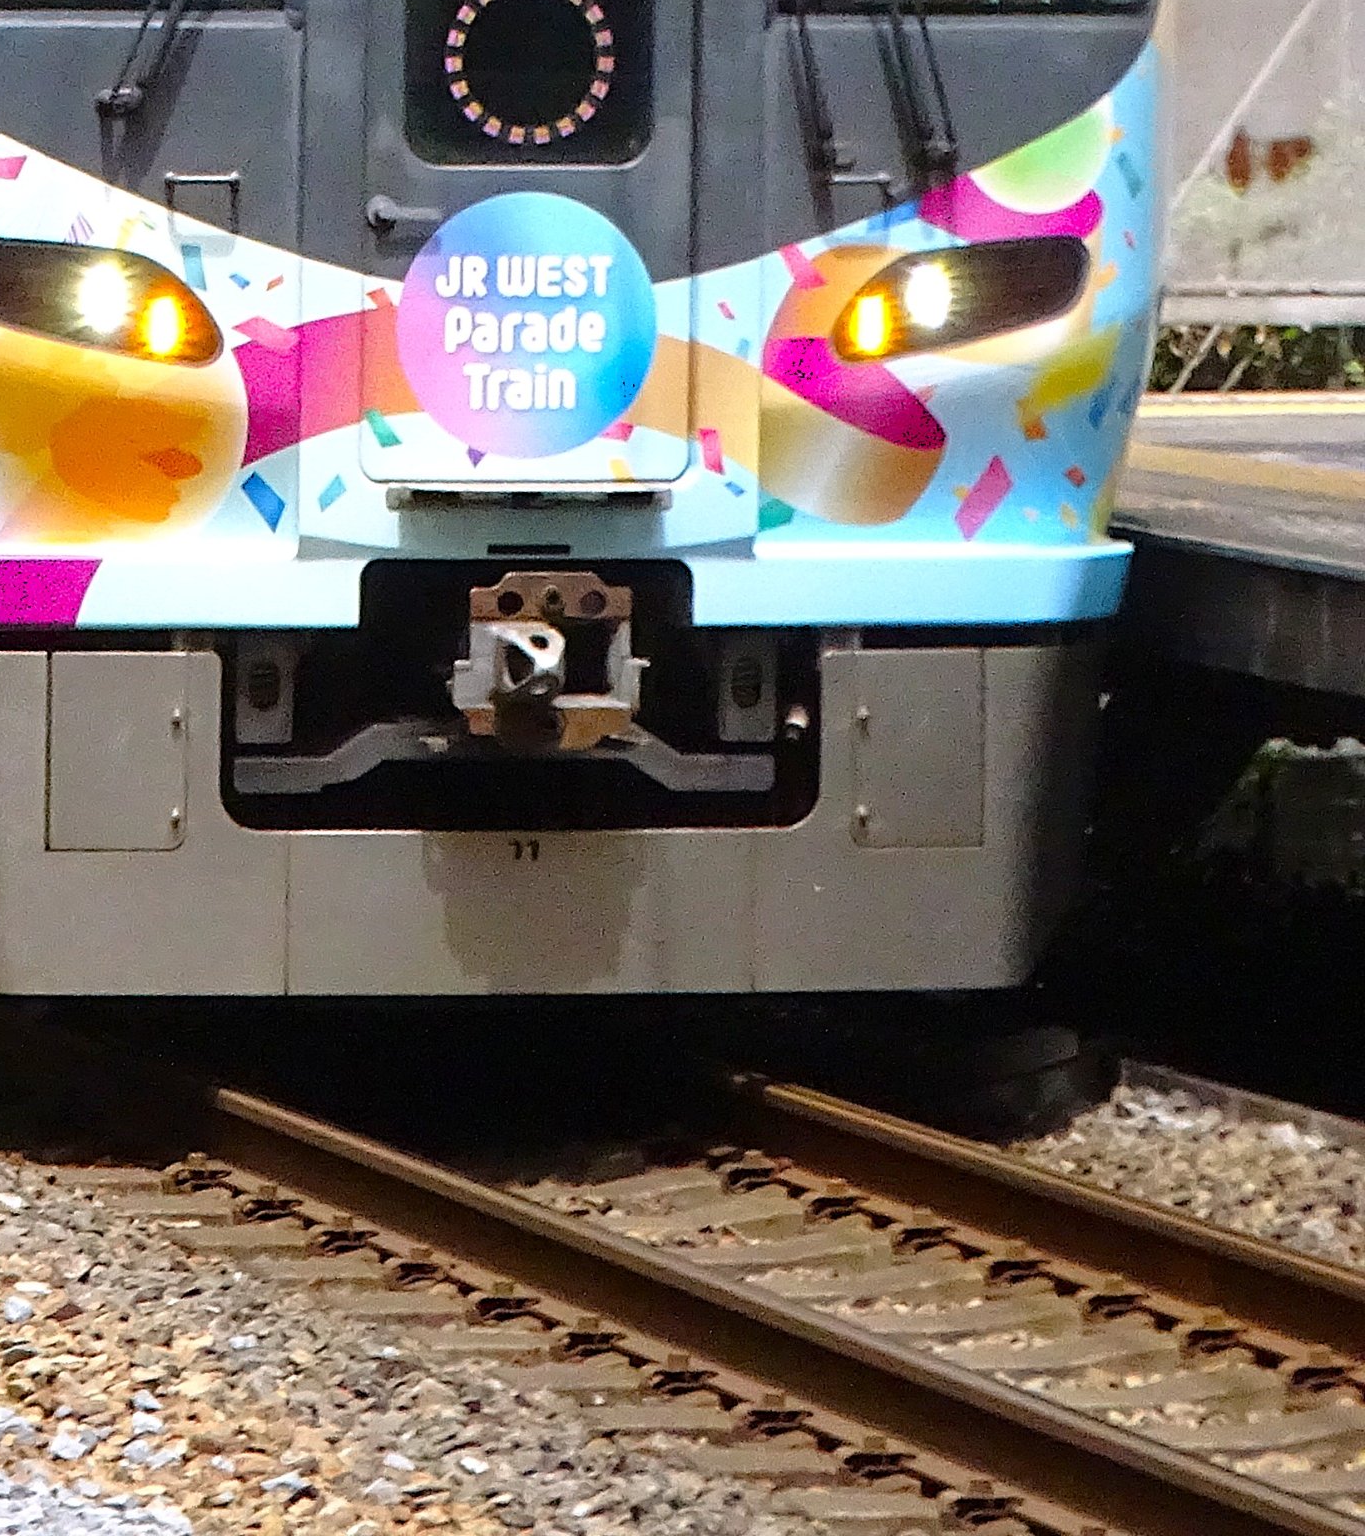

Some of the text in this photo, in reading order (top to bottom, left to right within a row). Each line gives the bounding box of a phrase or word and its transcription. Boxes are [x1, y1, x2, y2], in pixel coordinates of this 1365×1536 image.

[435, 254, 613, 298] JR WEST
[443, 305, 607, 355] Parade
[462, 362, 577, 411] Train
